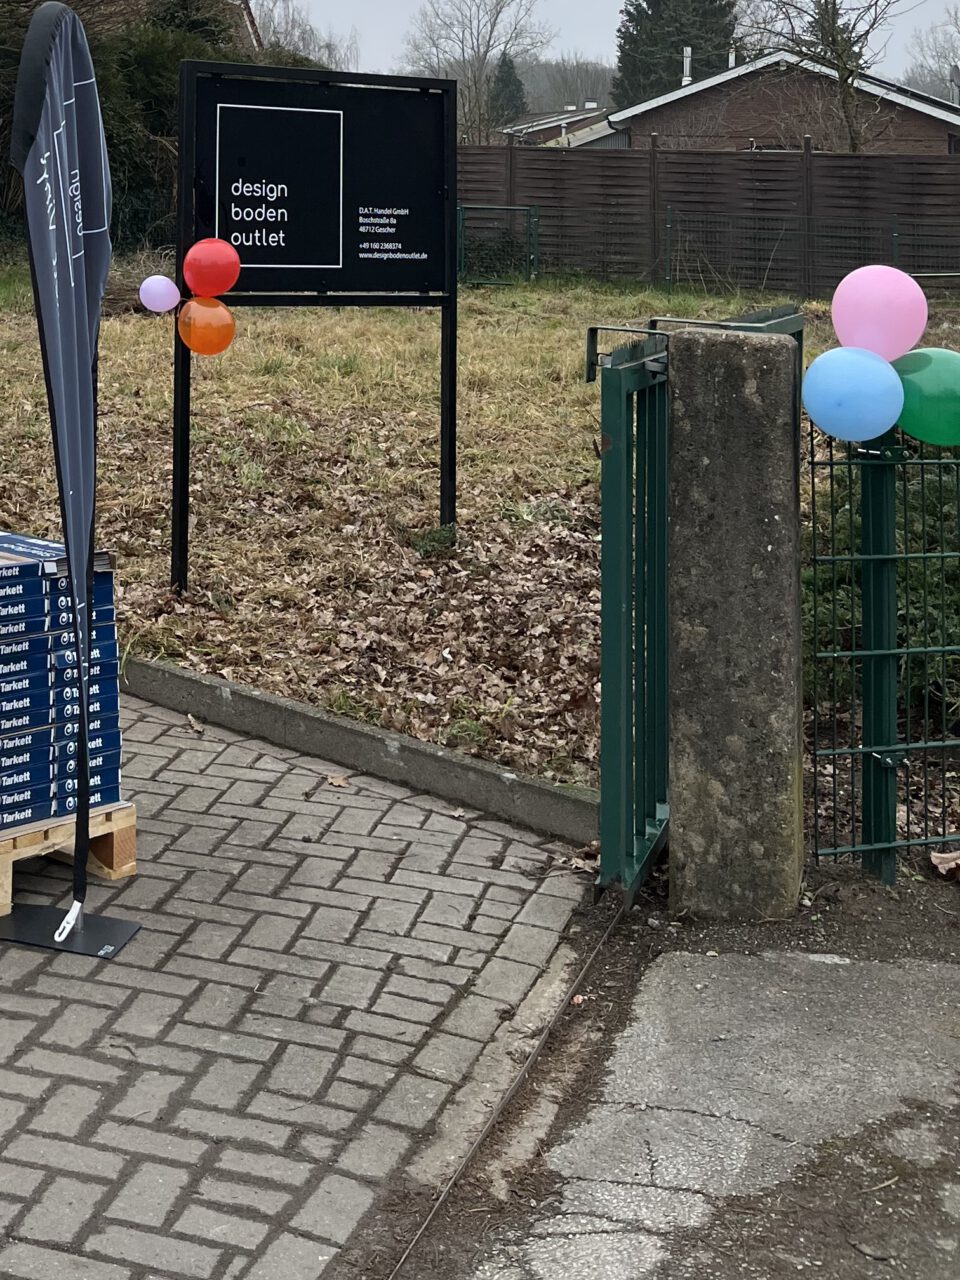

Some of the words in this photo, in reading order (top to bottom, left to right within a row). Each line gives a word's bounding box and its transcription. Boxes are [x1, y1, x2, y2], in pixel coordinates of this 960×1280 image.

[231, 178, 287, 201] design
[231, 203, 287, 221] boden
[231, 229, 286, 247] outlet
[359, 252, 428, 260] www.designbodenoutlet.de
[0, 642, 29, 655] Tarkett
[0, 679, 29, 693] Tarkett
[1, 697, 30, 712] Tarkett
[0, 716, 30, 729] Tarkett
[2, 735, 32, 749] Tarkett
[1, 753, 30, 767] Tarkett
[1, 771, 31, 786] Tarkett
[1, 791, 31, 805] Tarkett
[2, 809, 32, 823] Tarkett
